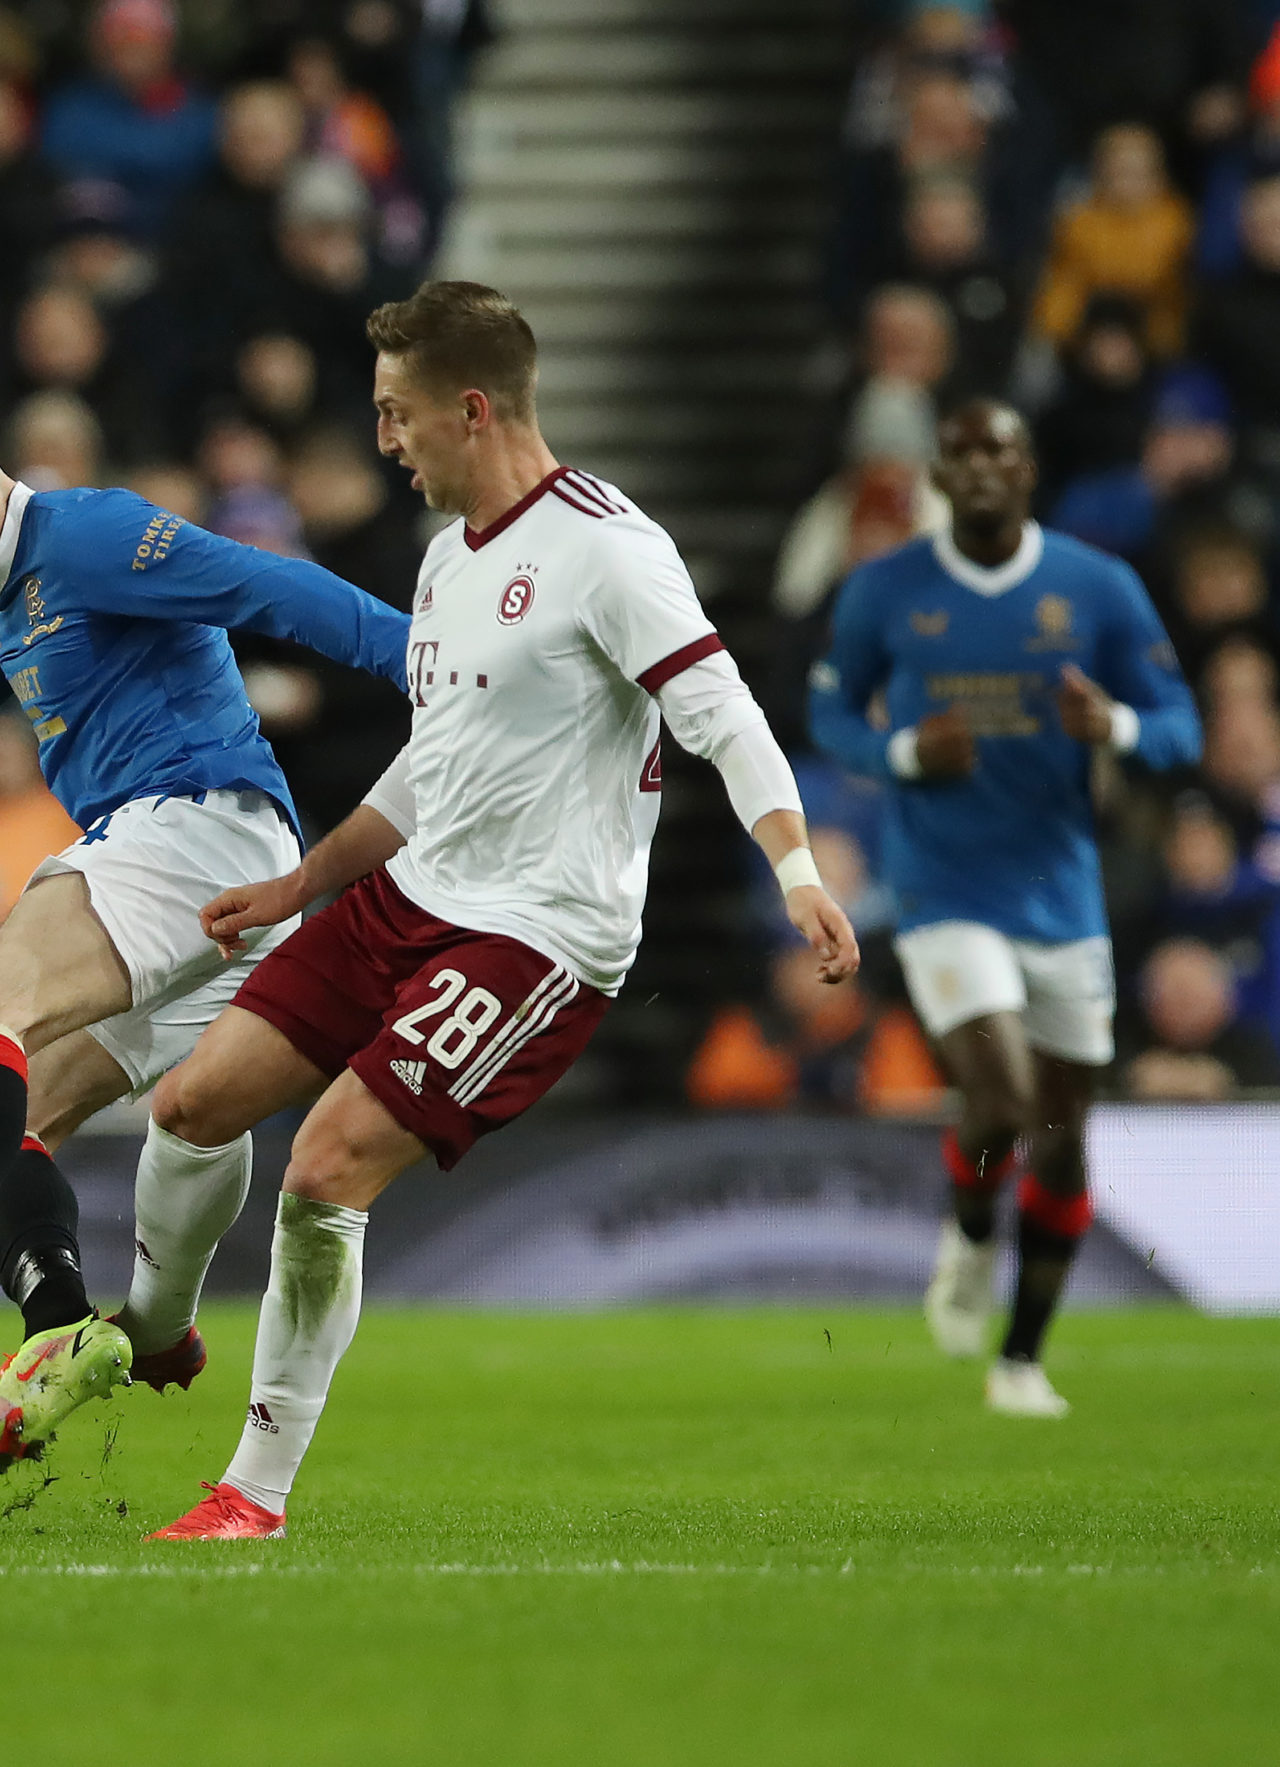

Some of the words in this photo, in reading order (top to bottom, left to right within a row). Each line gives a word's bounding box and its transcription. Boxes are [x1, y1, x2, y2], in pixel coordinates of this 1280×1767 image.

[504, 584, 527, 614] S
[391, 968, 502, 1070] 28
[389, 1059, 423, 1096] adidas
